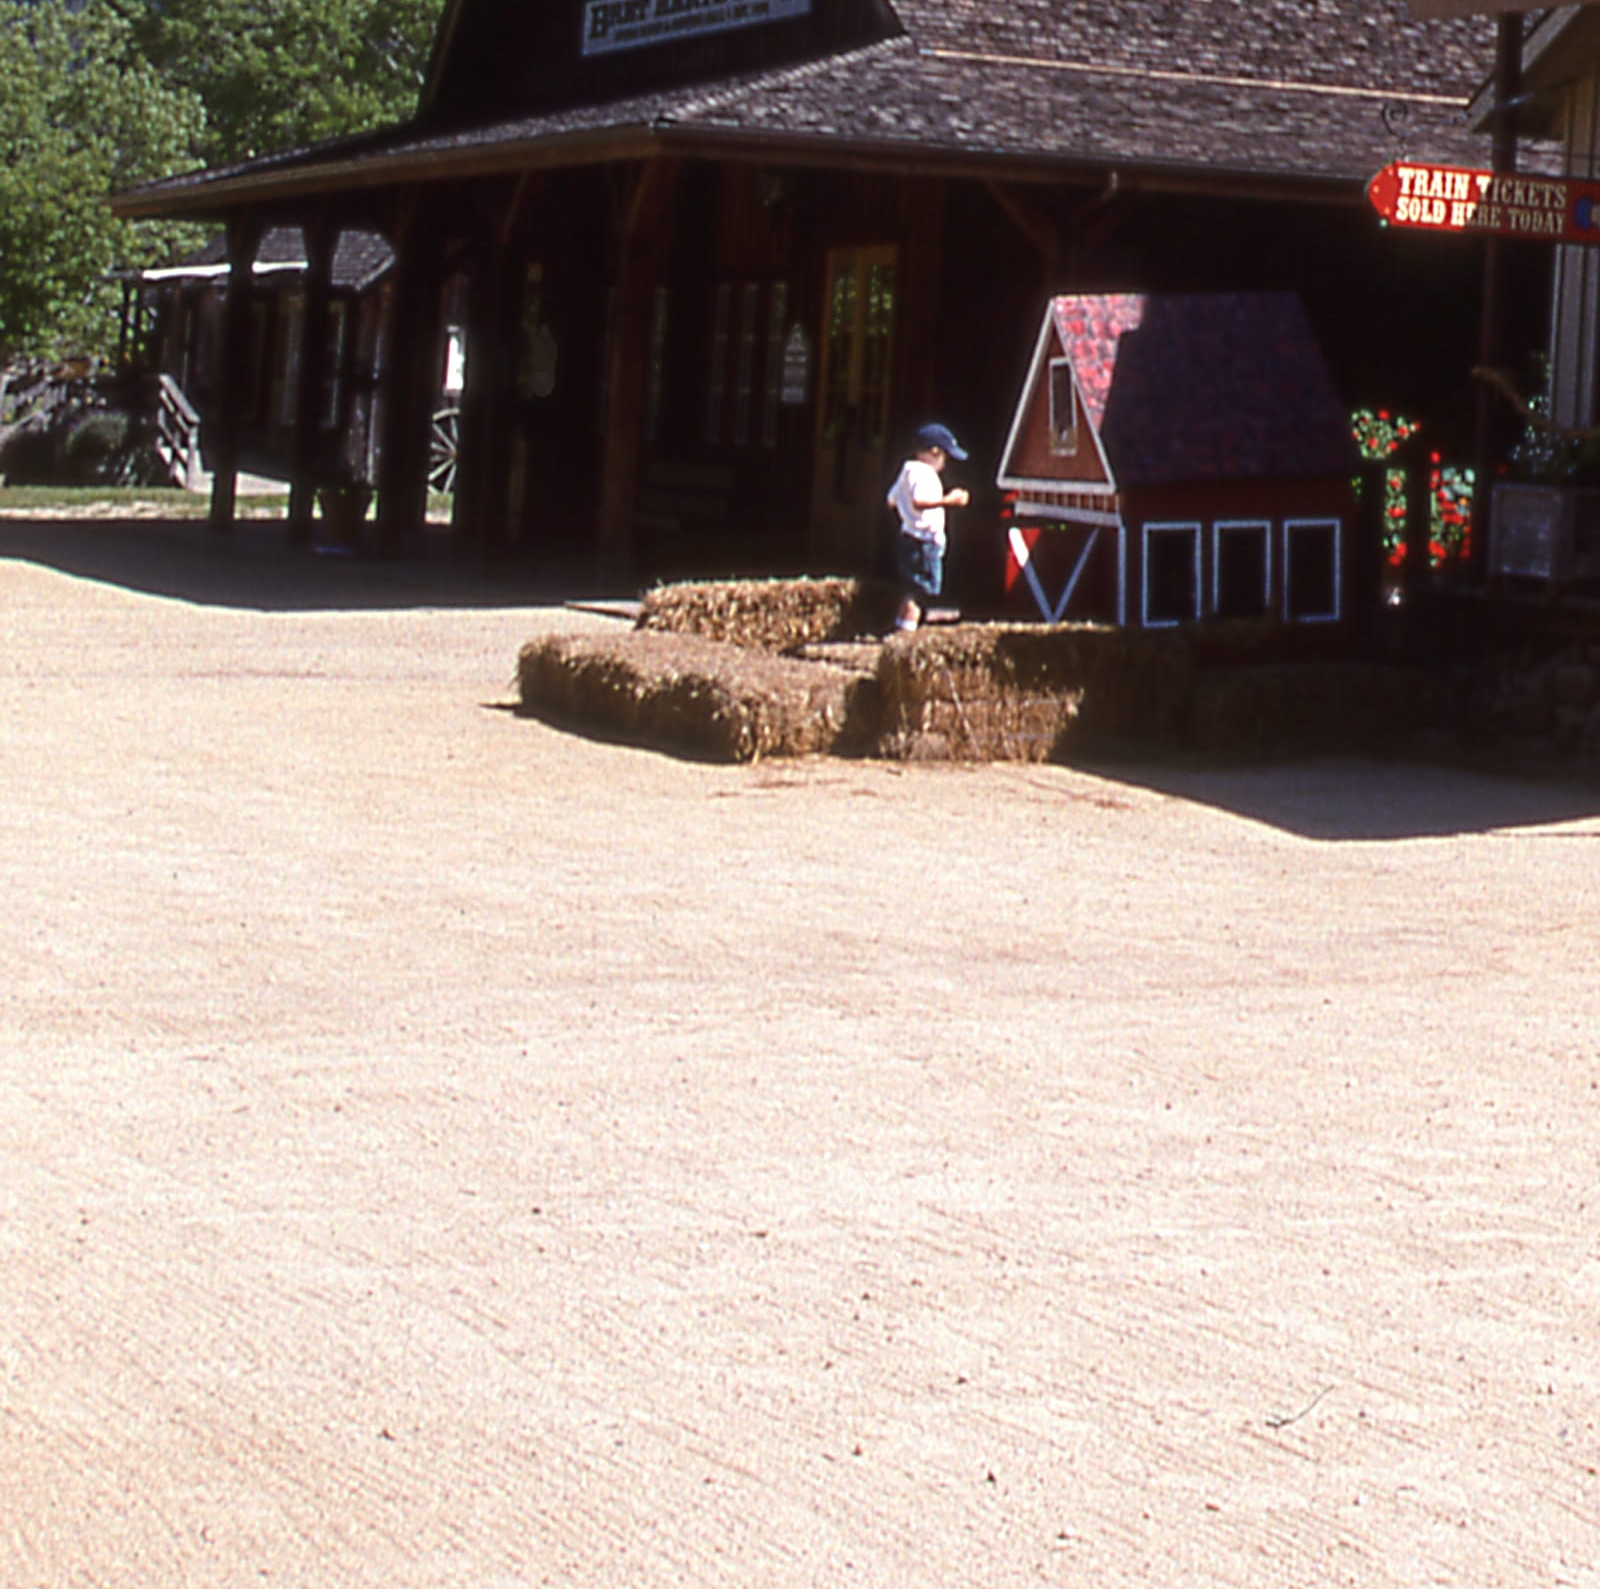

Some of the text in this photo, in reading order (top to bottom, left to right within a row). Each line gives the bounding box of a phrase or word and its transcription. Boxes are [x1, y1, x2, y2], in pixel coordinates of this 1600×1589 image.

[1397, 167, 1567, 210] TRAIN TICKETS
[1396, 197, 1566, 234] SOLD HERE TODAY
